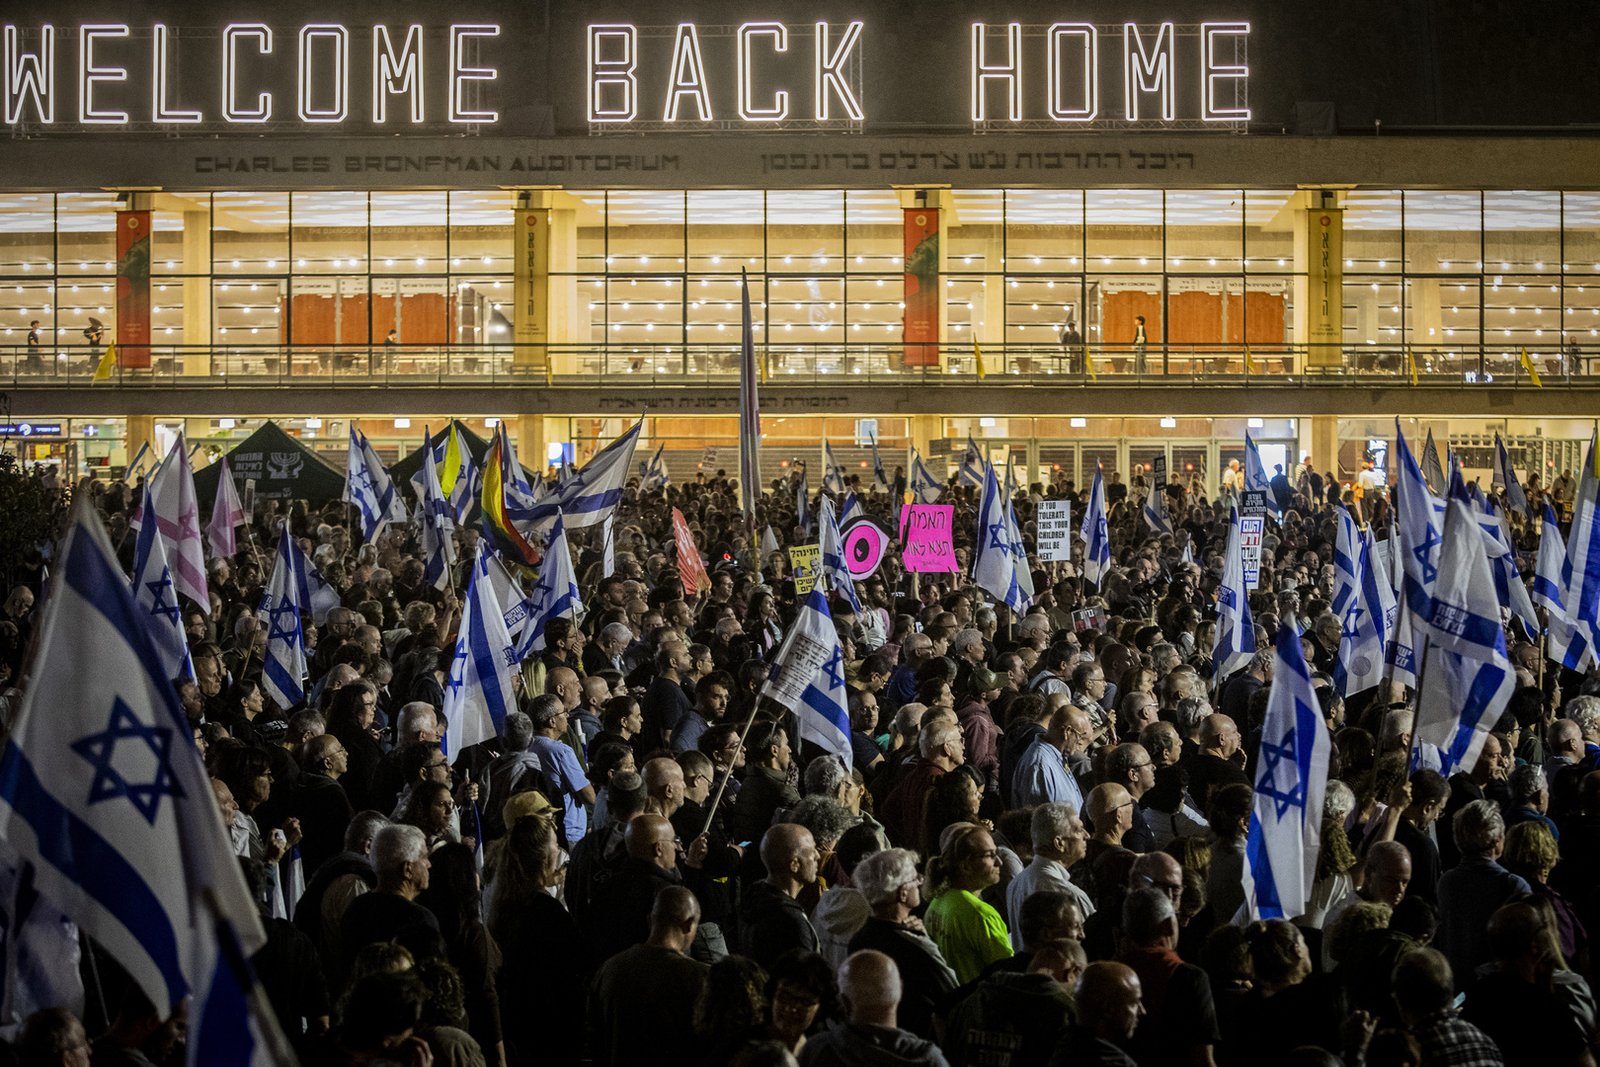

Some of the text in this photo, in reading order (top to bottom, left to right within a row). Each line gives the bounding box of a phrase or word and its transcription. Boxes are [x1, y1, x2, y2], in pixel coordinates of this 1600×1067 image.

[4, 21, 1252, 125] WELCOME BACK HOME
[194, 154, 680, 174] CHARLES BRONFMAN AUDITORIUM
[760, 152, 869, 174] ברונפמן
[1015, 152, 1121, 170] התרבות
[1130, 149, 1195, 170] היכל
[1039, 502, 1056, 510] IF YOU
[1039, 511, 1065, 520] TOLERATE
[1039, 520, 1068, 529] THIS YOUR
[1039, 531, 1065, 539] CHILDREN
[1039, 541, 1060, 550] WILL BE
[1039, 552, 1053, 560] NEXT
